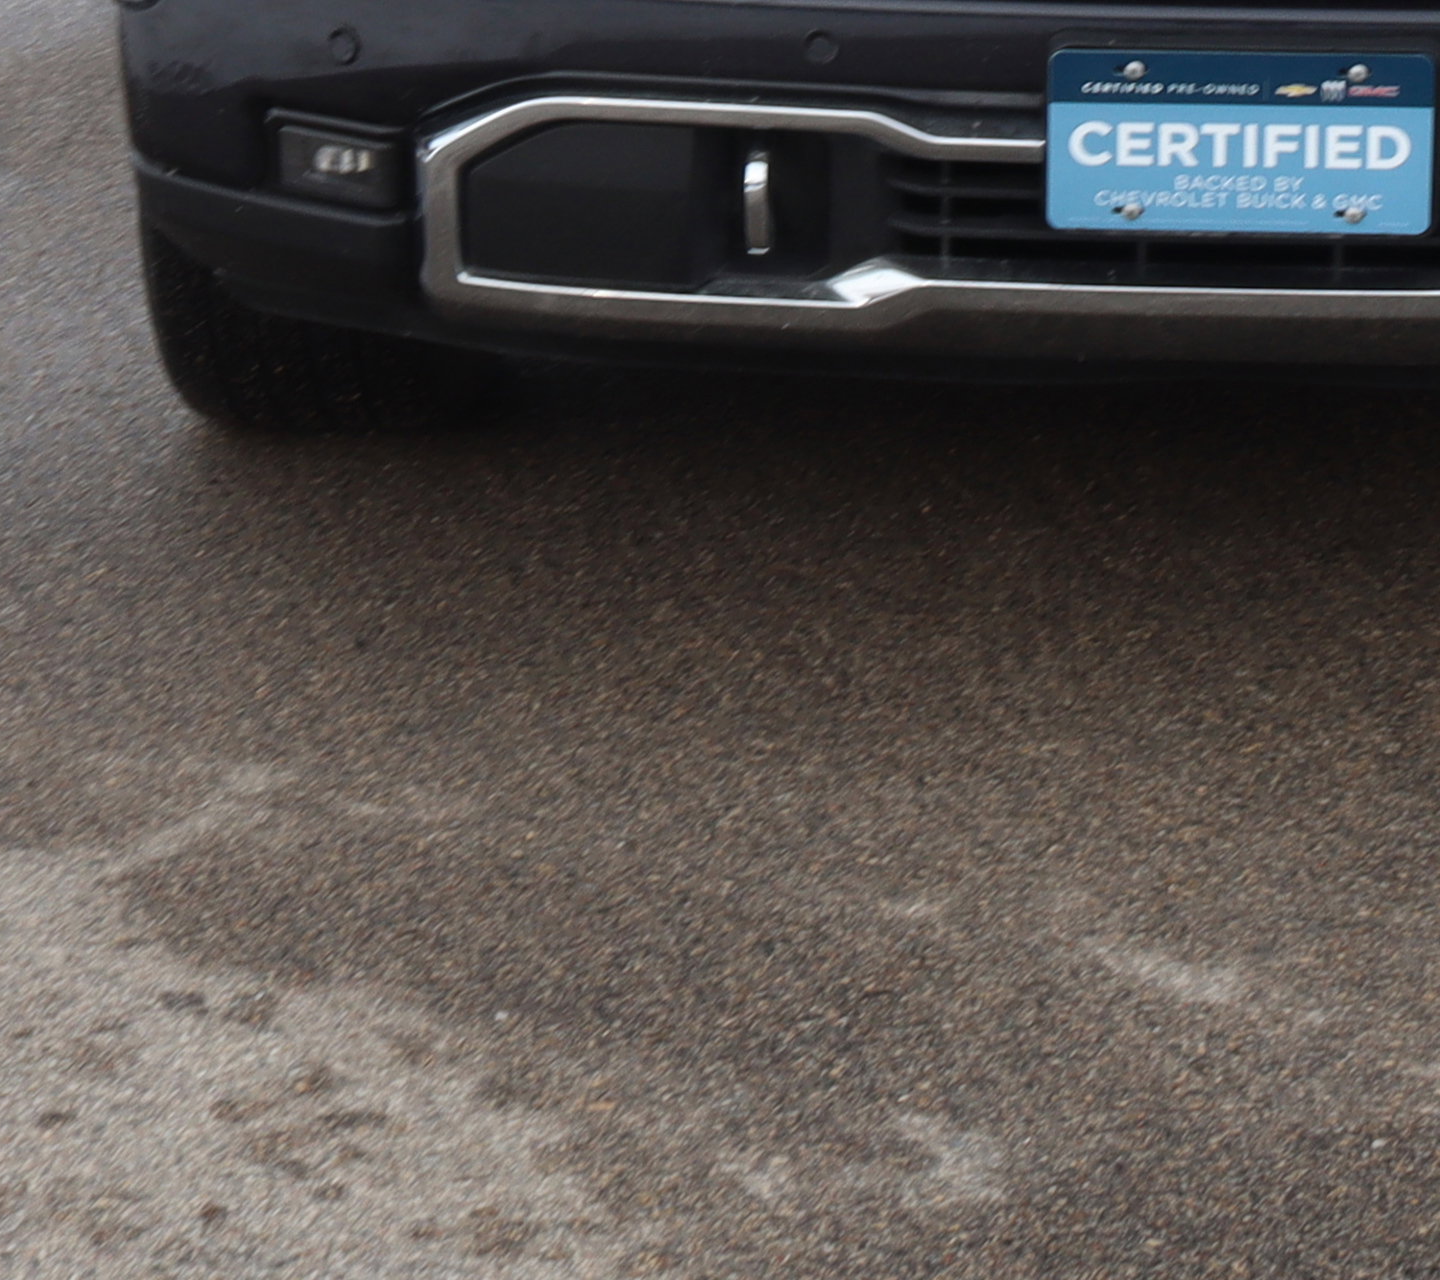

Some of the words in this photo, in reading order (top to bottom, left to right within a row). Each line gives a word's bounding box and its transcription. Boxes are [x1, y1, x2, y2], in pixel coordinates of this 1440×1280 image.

[1081, 82, 1163, 95] CERTIFIED
[1167, 83, 1260, 96] PRE-OWNED
[1068, 120, 1412, 170] CERTIFIED
[1174, 175, 1266, 192] BACKED
[1274, 176, 1304, 192] BY
[1093, 190, 1229, 208] CHEVROLET
[1236, 191, 1307, 209] BUICK
[1311, 194, 1327, 209] &
[1333, 193, 1383, 211] GMC
